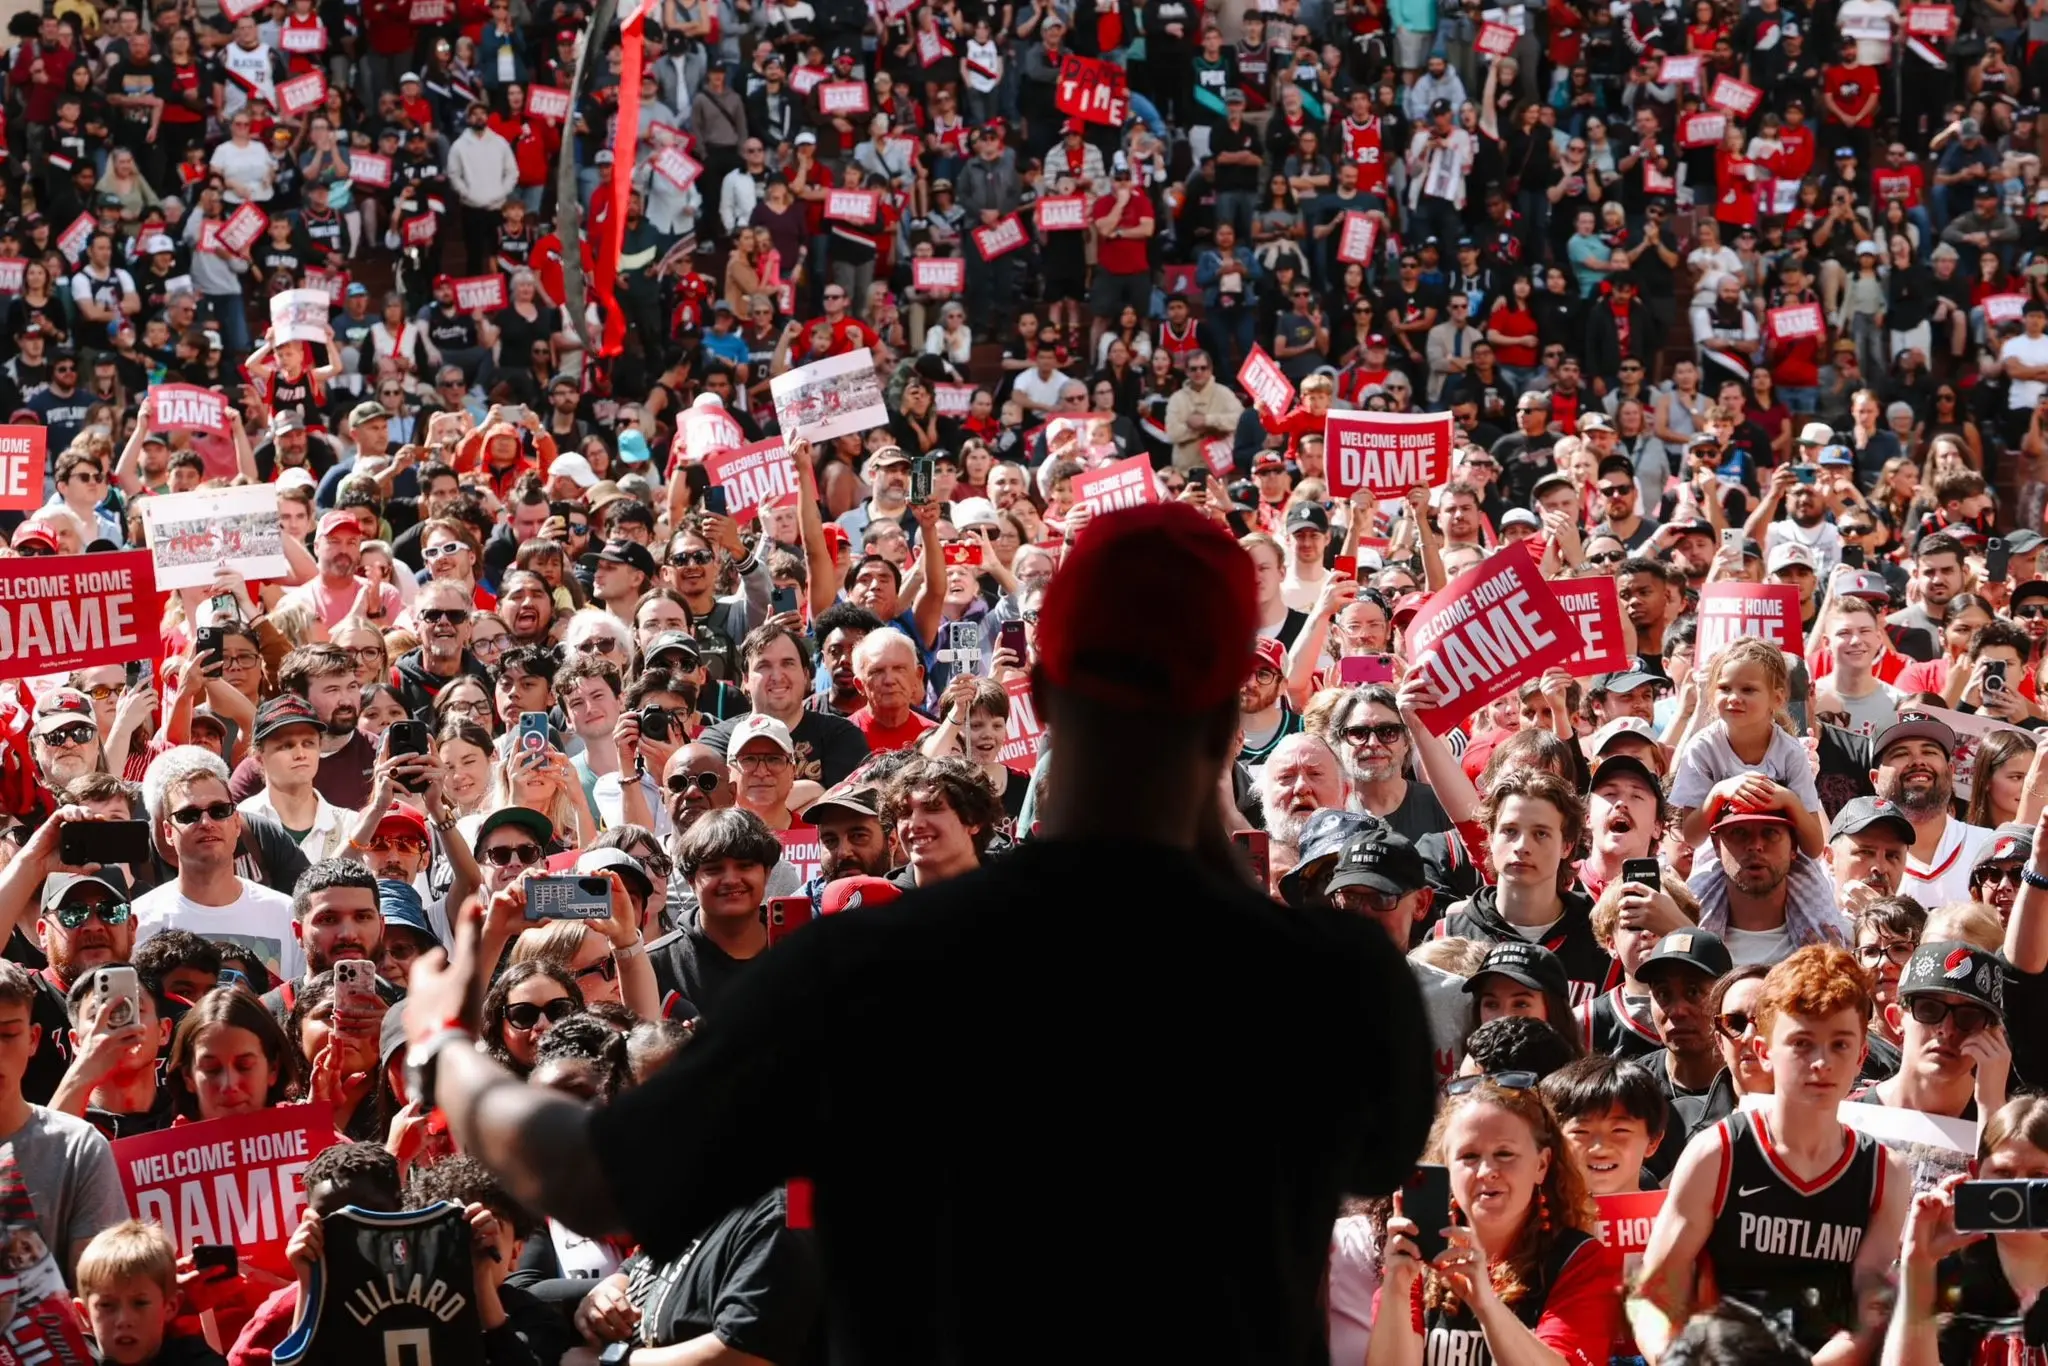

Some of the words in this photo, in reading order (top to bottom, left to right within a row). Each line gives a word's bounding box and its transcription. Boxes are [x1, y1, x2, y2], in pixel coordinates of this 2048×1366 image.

[1063, 80, 1124, 126] TIME
[157, 402, 223, 429] DAME
[0, 438, 31, 454] OME
[1340, 431, 1397, 449] WELCOME
[1399, 433, 1436, 449] HOME
[717, 455, 764, 479] WELCOME
[764, 447, 790, 464] HOM
[1341, 449, 1436, 488] DAME
[722, 457, 799, 513] DAME
[1082, 475, 1122, 498] WELCOME
[1121, 467, 1144, 484] HOME
[74, 569, 133, 595] HOME
[1413, 594, 1477, 650] WELCOME
[1472, 566, 1523, 610] HOME
[1745, 598, 1783, 616] HOME
[1417, 589, 1557, 708] DAME
[785, 843, 820, 861] HOM
[131, 1141, 236, 1187] WELCOME
[240, 1129, 309, 1164] HOME
[1739, 1212, 1862, 1264] PORTLAND
[344, 1273, 466, 1327] LILLARD
